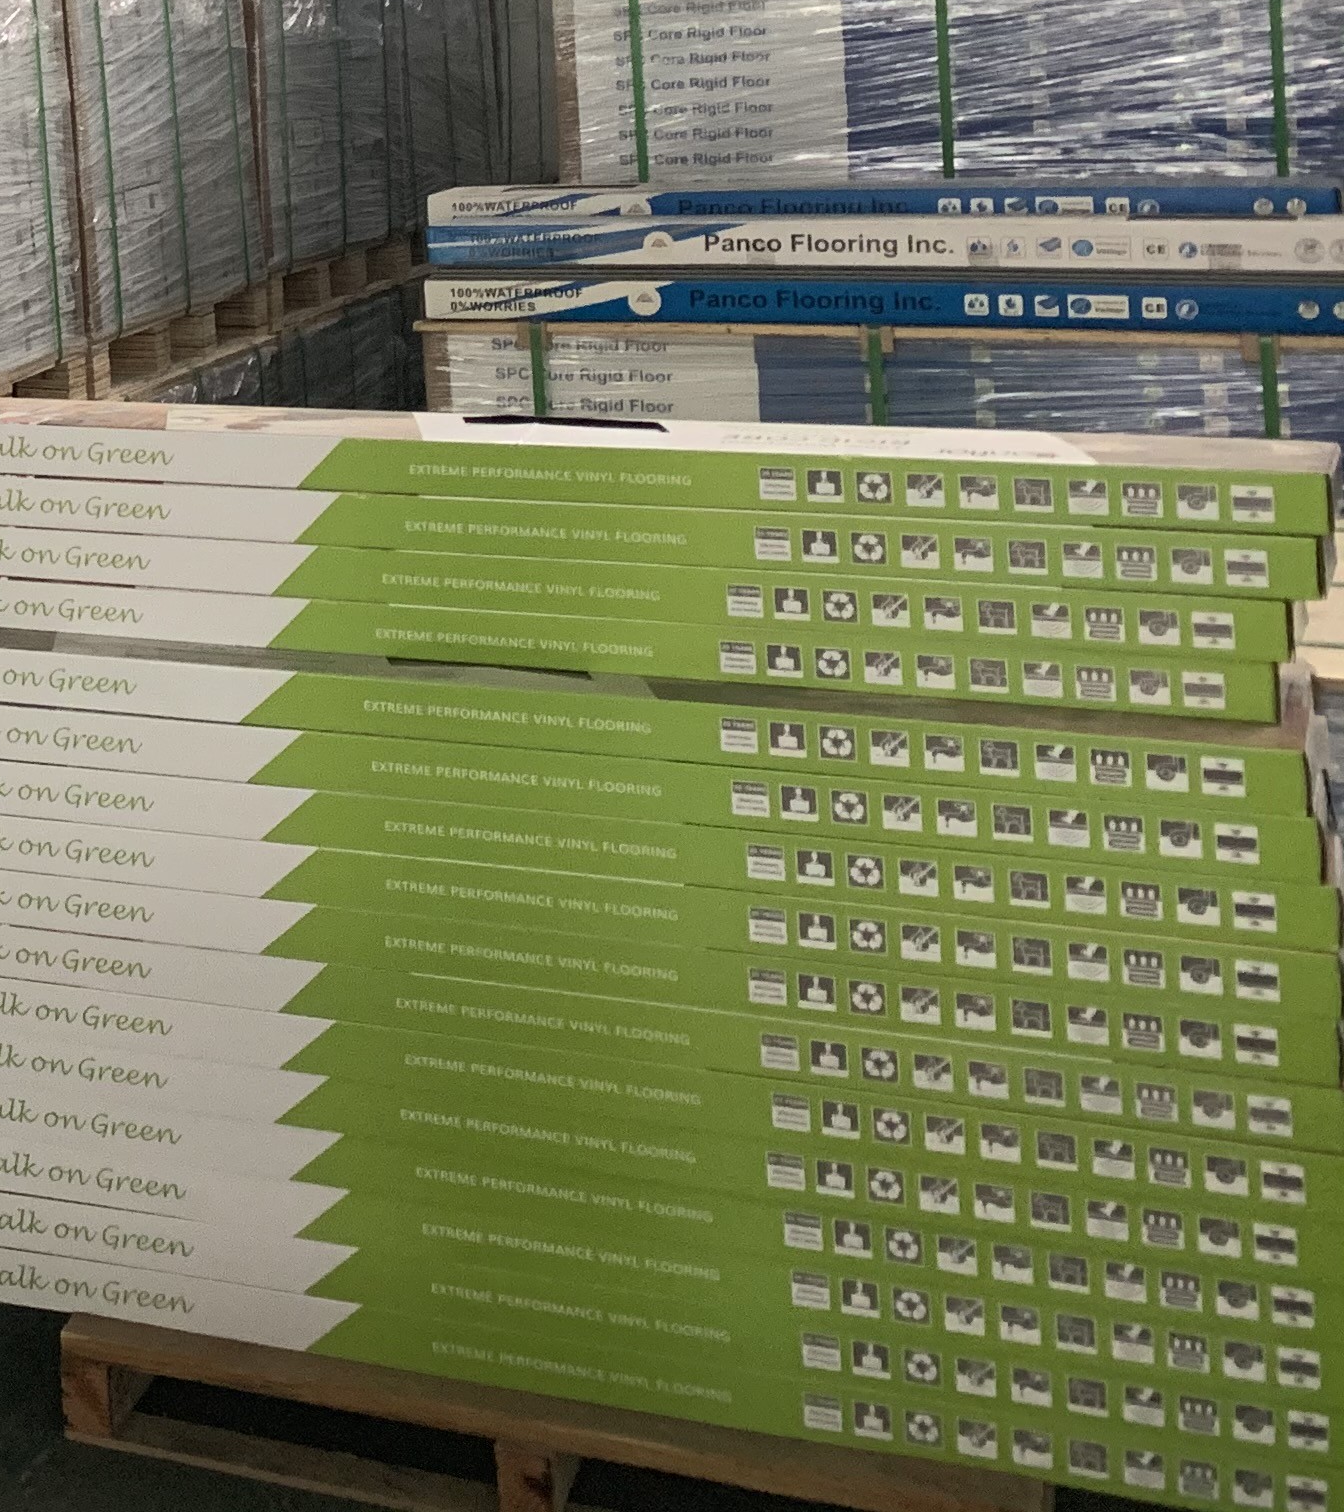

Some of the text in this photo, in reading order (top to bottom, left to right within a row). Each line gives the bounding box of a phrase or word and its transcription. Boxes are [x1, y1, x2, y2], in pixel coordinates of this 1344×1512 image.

[648, 29, 682, 40] Core
[687, 27, 725, 41] Rigid
[730, 26, 767, 36] Floor
[651, 78, 685, 89] Core
[690, 76, 727, 91] Rigid
[733, 76, 770, 87] Floor
[704, 234, 954, 257] Panco Flooring Inc.
[690, 289, 942, 313] Panco Flooring Inc.
[495, 367, 530, 380] SPC
[629, 369, 673, 382] Floor
[42, 444, 81, 462] on
[87, 442, 173, 466] Green
[407, 463, 692, 486] EXTREME PERFORMANCE VINYL FLOORING
[40, 498, 79, 515] on
[85, 495, 170, 520] Green
[403, 520, 687, 545] EXTREME PERFORMANCE VINYL FLOORING
[21, 546, 60, 565] on
[65, 545, 150, 570] Green
[380, 573, 661, 602] EXTREME PERFORMANCE VINYL FLOORING
[14, 599, 53, 617] on
[58, 598, 143, 624] Green
[374, 628, 654, 657] EXTREME PERFORMANCE VINYL FLOORING
[3, 668, 43, 688] on
[49, 668, 137, 695] Green
[362, 700, 652, 734] EXTREME PERFORMANCE VINYL FLOORING
[6, 726, 48, 745] on
[53, 726, 142, 754] Green
[370, 760, 662, 797] EXTREME PERFORMANCE VINYL FLOORING
[18, 783, 59, 803] on
[64, 783, 154, 812] Green
[18, 839, 60, 858] on
[65, 839, 154, 868] Green
[383, 821, 677, 859] EXTREME PERFORMANCE VINYL FLOORING
[17, 892, 59, 913] on
[64, 893, 154, 923] Green
[384, 879, 679, 921] EXTREME PERFORMANCE VINYL FLOORING
[15, 947, 57, 967] on
[62, 948, 151, 979] Green
[383, 935, 679, 981] EXTREME PERFORMANCE VINYL FLOORING
[35, 1004, 77, 1024] on
[82, 1005, 172, 1036] Green
[31, 1055, 73, 1077] on
[78, 1057, 168, 1089] Green
[44, 1111, 86, 1131] on
[91, 1113, 182, 1146] Green
[48, 1165, 90, 1186] on
[96, 1167, 186, 1200] Green
[54, 1222, 95, 1243] on
[102, 1225, 194, 1258] Green
[54, 1278, 97, 1299] on
[102, 1281, 194, 1314] Green
